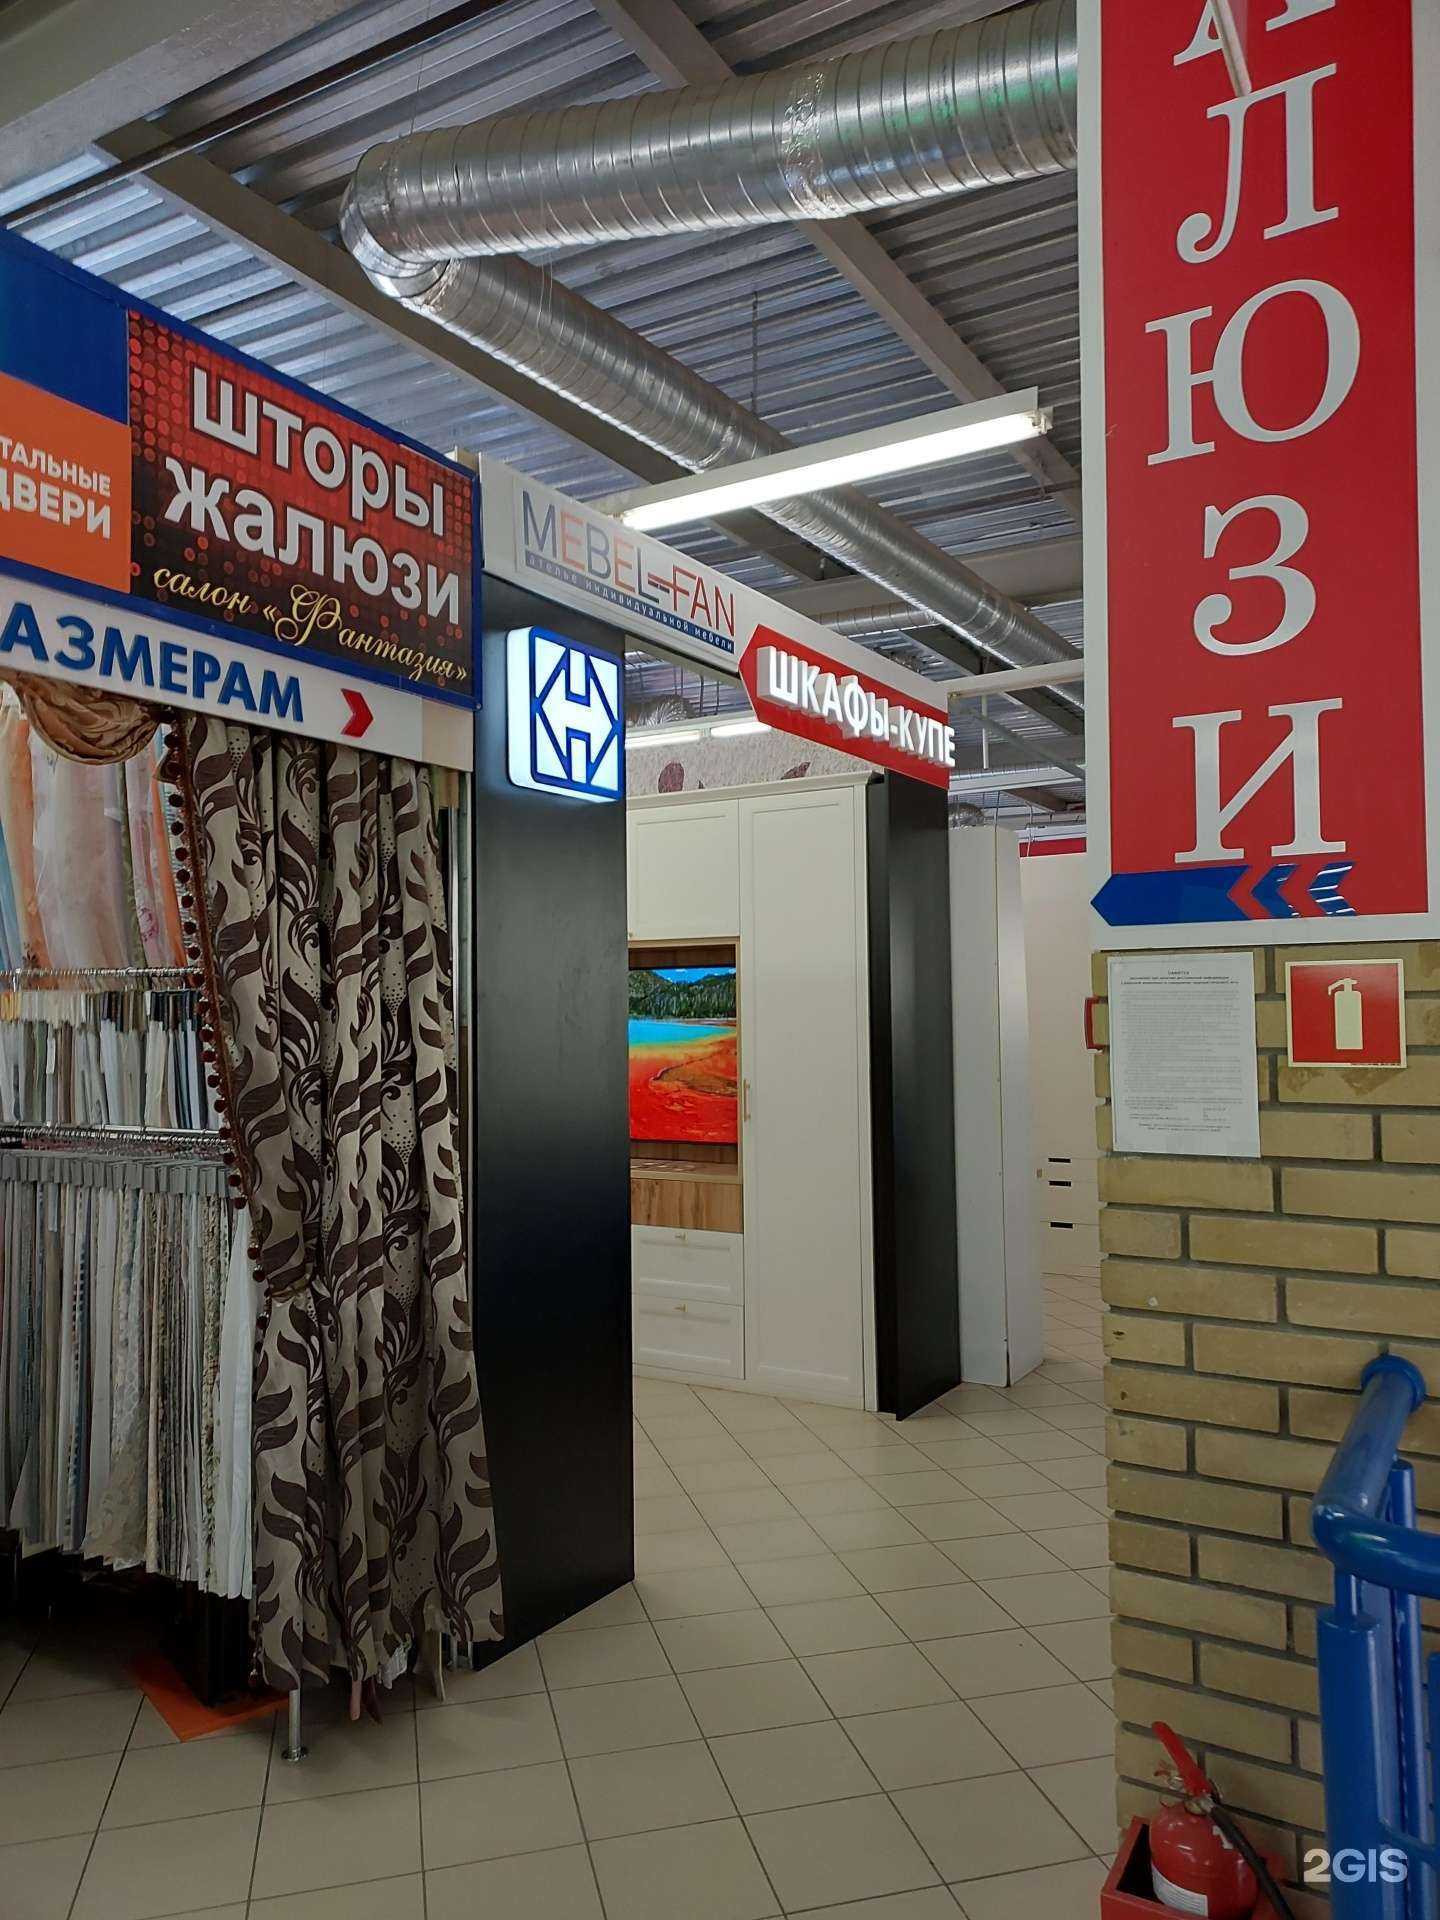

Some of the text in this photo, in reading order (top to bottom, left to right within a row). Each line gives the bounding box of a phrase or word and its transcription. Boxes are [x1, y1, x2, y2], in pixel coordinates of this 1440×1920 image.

[0, 601, 304, 722] АЗМЕРАМ
[153, 567, 468, 682] салон «Фантазия»
[529, 554, 734, 651] ателье индивидуальной мебели
[759, 646, 956, 768] ШКАФЫ-КУПЕ
